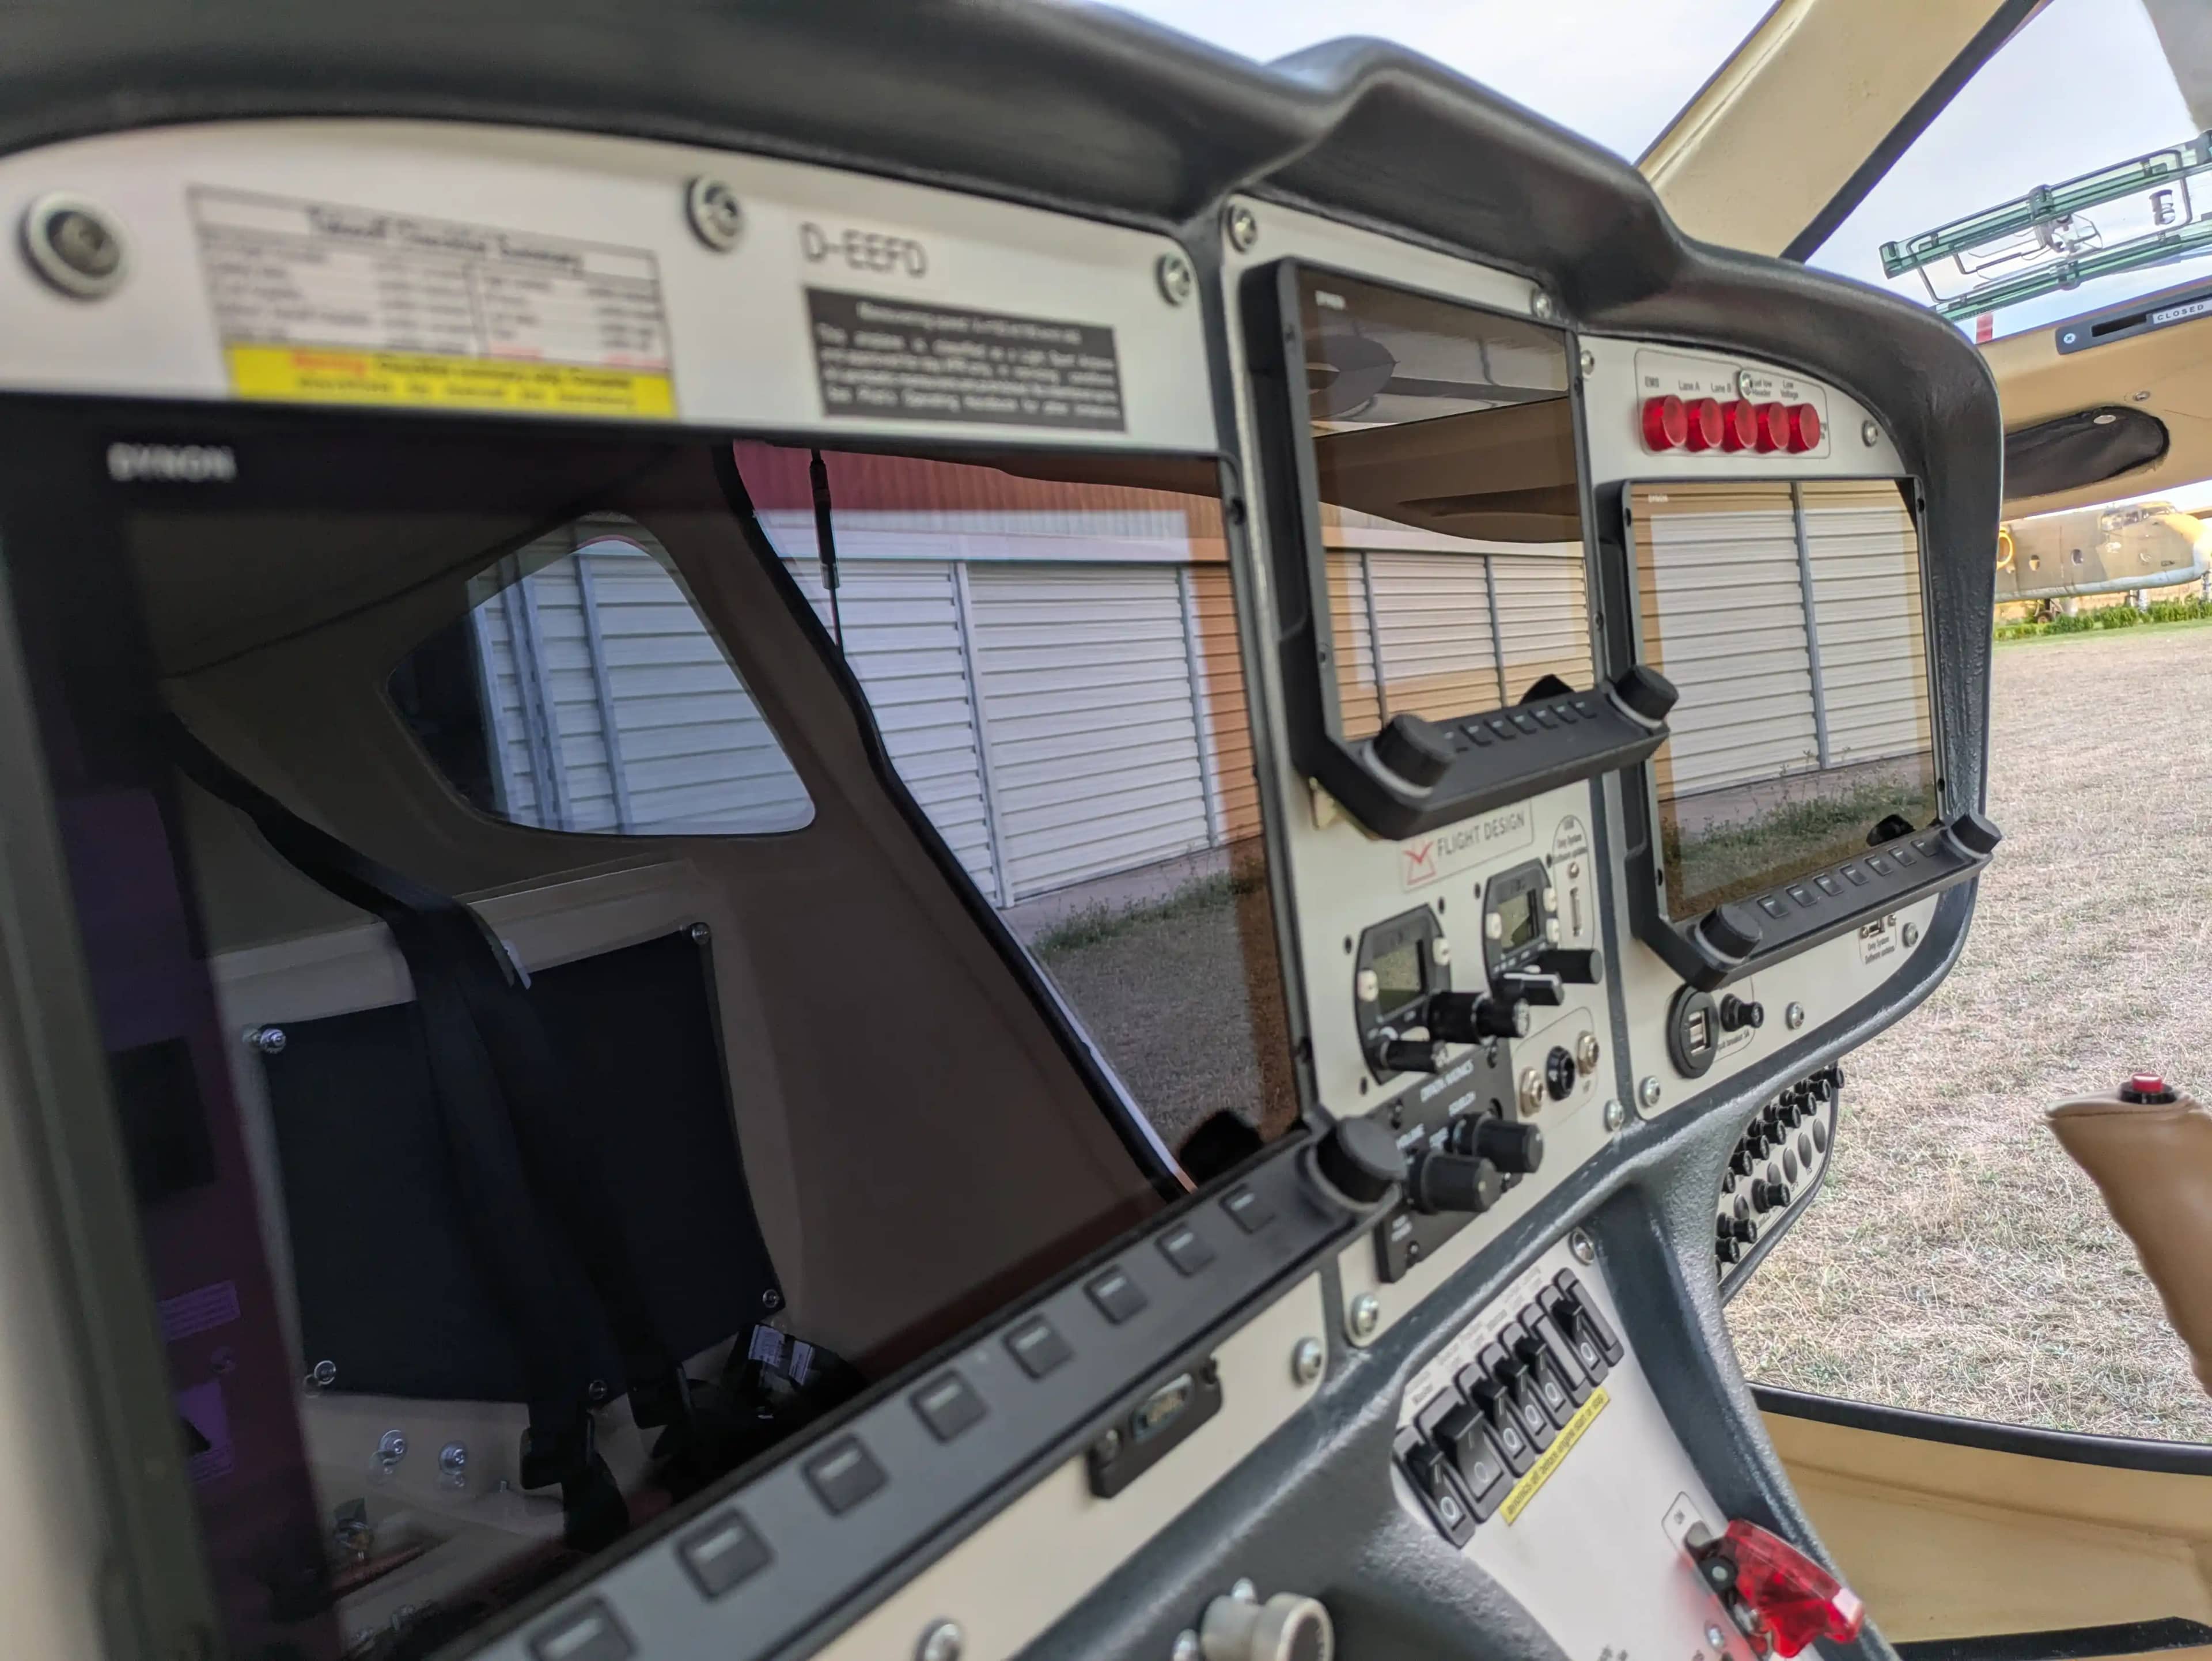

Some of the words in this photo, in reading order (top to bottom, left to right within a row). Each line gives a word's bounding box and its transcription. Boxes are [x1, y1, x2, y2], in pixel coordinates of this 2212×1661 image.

[798, 221, 929, 279] D-EEFD
[2157, 304, 2204, 321] CLOSED
[1678, 379, 1694, 391] Lane
[1695, 381, 1700, 391] A
[1710, 382, 1726, 393] Lane
[1437, 824, 1480, 857] FLIGHT
[1483, 810, 1525, 841] DESIGN
